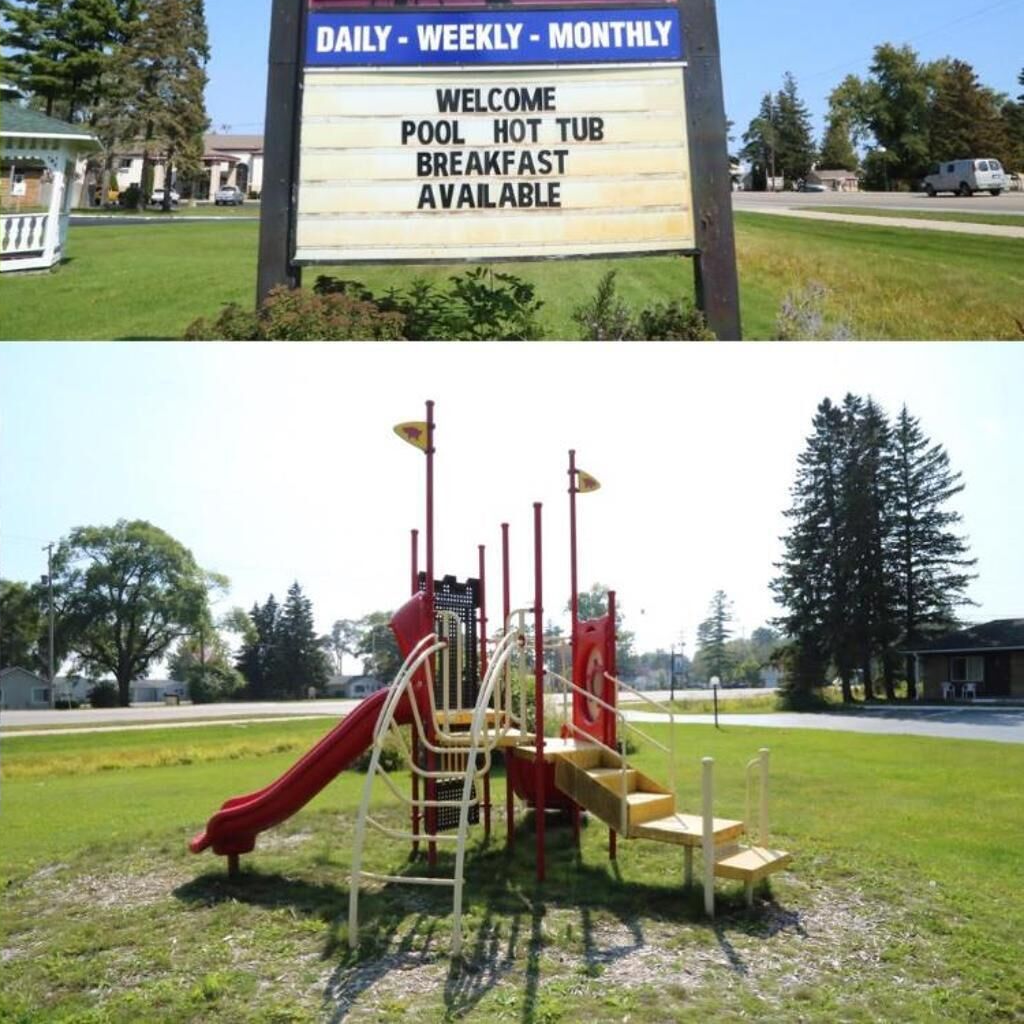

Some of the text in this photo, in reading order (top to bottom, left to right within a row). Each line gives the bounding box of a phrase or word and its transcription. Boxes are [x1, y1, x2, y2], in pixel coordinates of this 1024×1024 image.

[316, 25, 393, 53] DAILY
[416, 23, 524, 51] WEEKLY
[548, 20, 672, 49] MONTHLY
[436, 87, 556, 113] WELCOME
[401, 117, 604, 145] POOL HOT TUB
[417, 149, 569, 177] BREAKFAST
[417, 182, 561, 209] AVAILABLE
